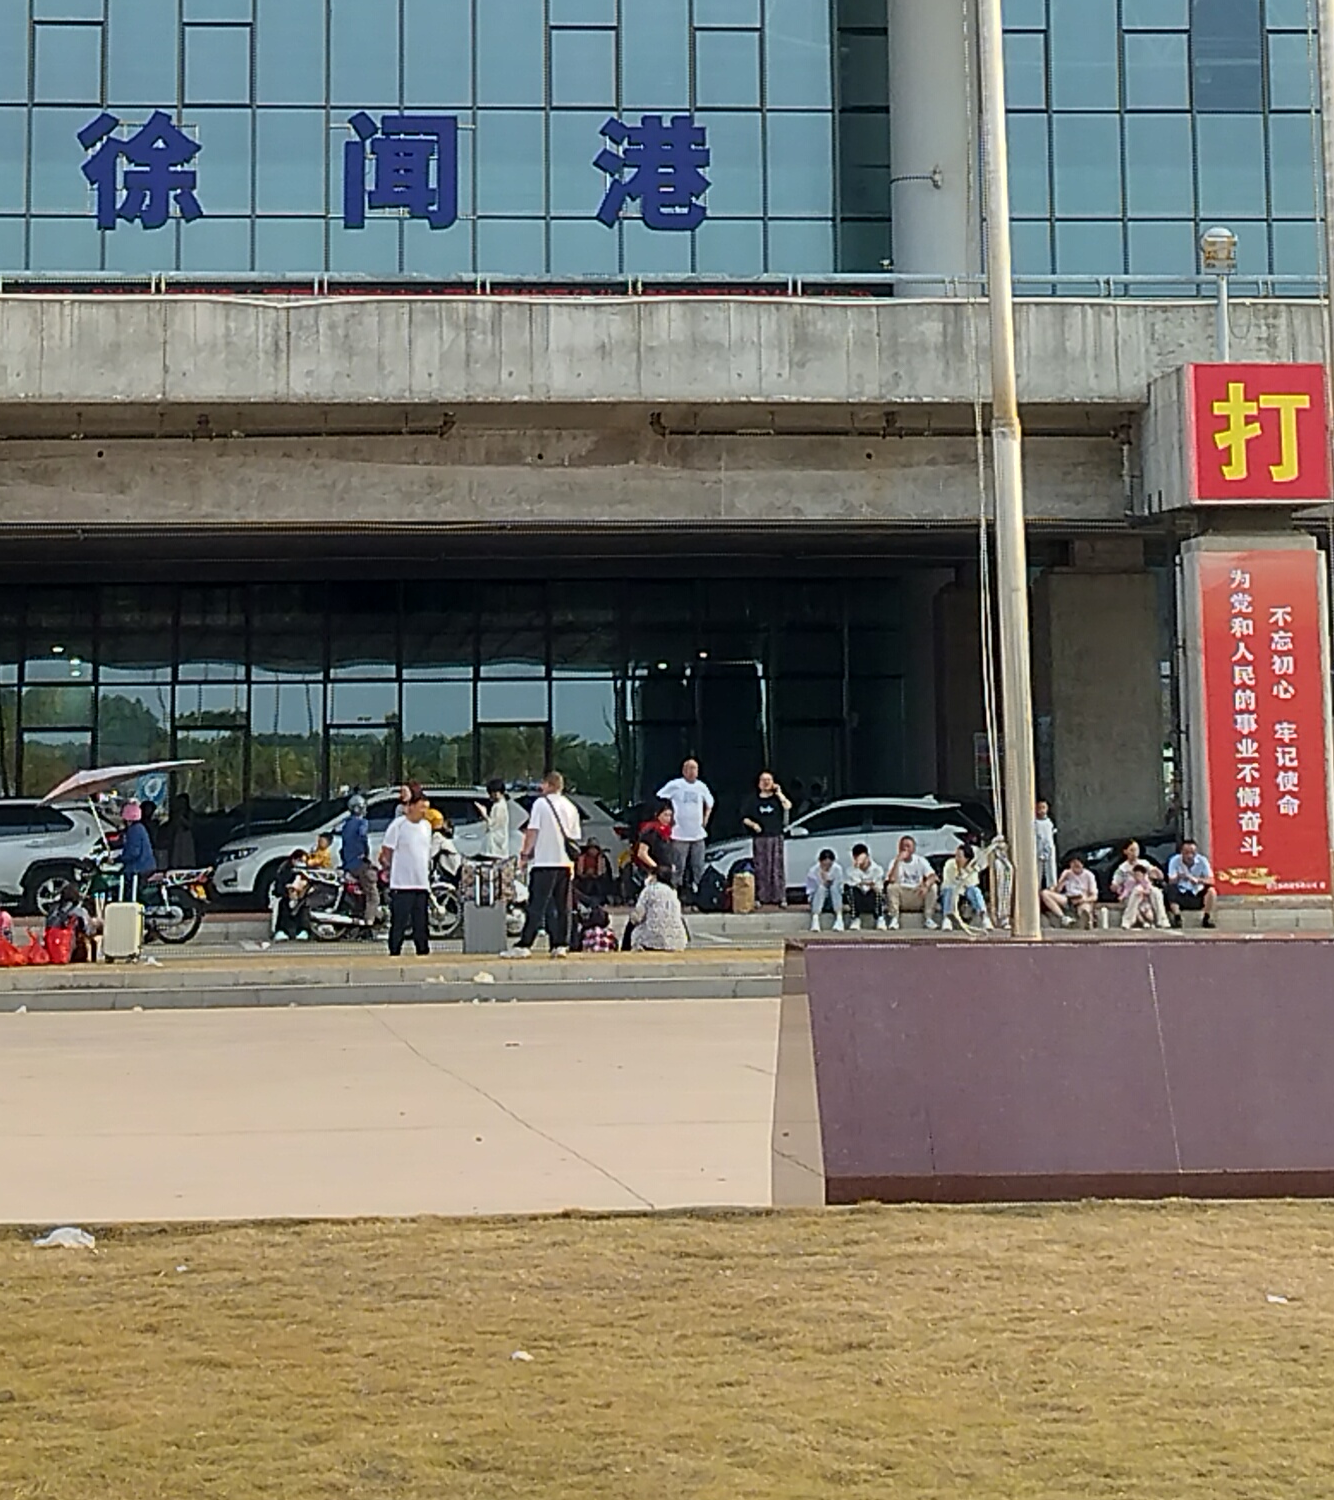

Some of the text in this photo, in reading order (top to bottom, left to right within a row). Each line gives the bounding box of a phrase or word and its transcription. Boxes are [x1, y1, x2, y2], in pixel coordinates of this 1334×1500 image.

[77, 110, 711, 230] 徐闻港
[1212, 382, 1310, 482] 打
[1229, 568, 1263, 858] 为党和人民的事业不懈奋斗
[1268, 606, 1301, 817] 不忘初心 牢记使命
